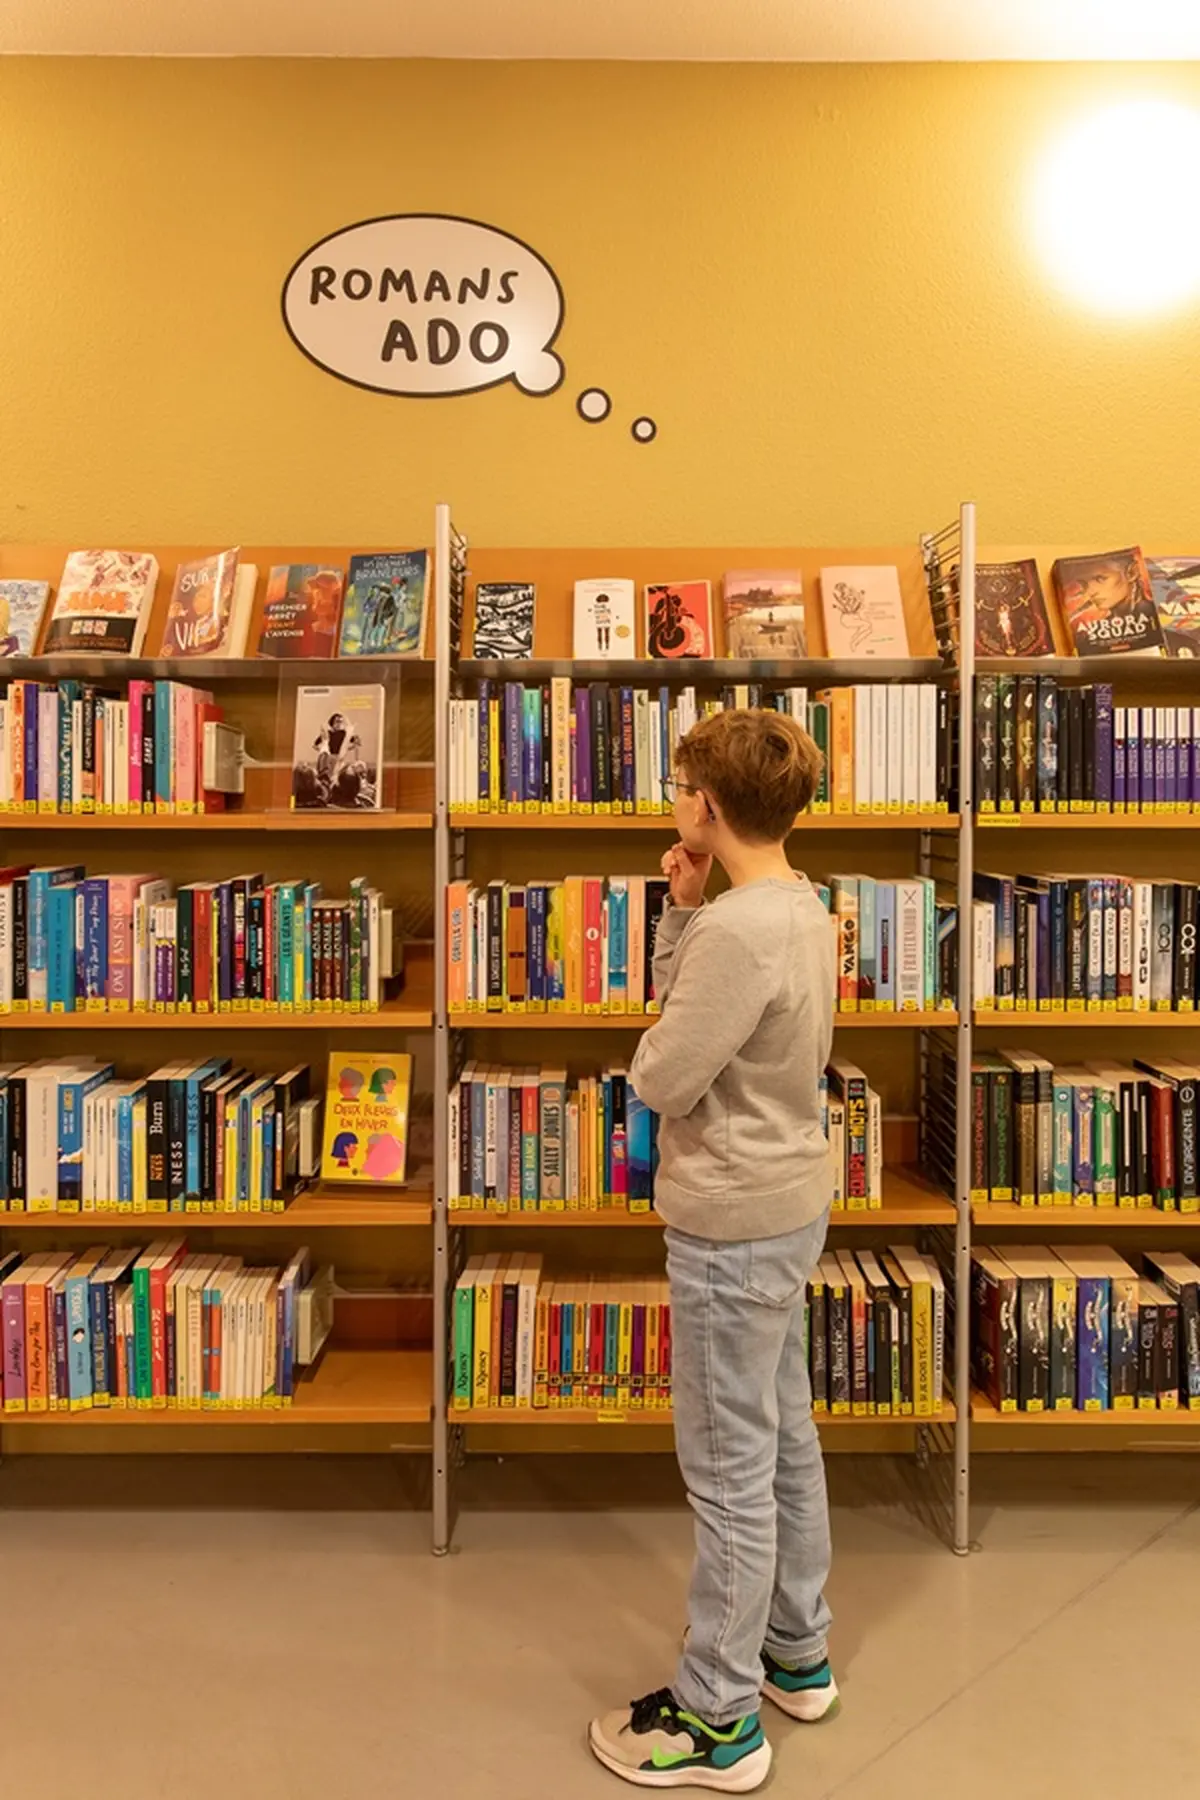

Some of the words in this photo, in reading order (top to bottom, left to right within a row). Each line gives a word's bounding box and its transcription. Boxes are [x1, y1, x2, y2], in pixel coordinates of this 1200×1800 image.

[310, 265, 518, 305] ROMANS
[381, 317, 509, 365] ADO
[180, 566, 209, 593] SUR
[269, 603, 308, 612] PREMIER
[1077, 612, 1149, 634] AURORA
[1087, 623, 1147, 641] SQUAD
[843, 919, 855, 975] VANGO
[149, 1100, 163, 1136] Burn
[543, 1106, 560, 1139] JONES
[171, 1141, 183, 1185] NESS
[543, 1145, 560, 1177] SALLY
